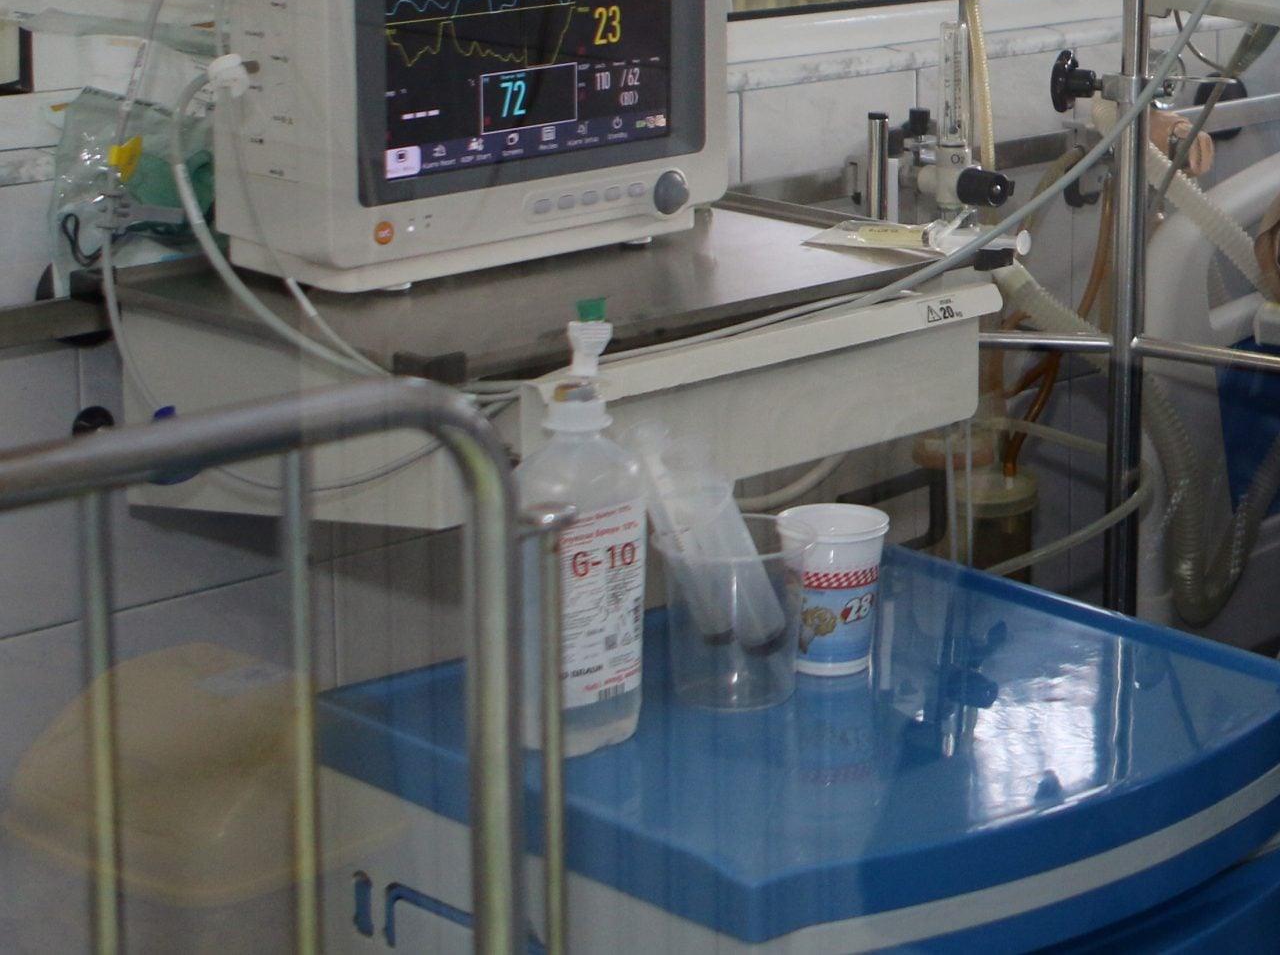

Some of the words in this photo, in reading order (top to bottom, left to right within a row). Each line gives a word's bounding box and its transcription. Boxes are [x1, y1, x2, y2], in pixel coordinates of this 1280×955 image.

[594, 5, 621, 45] 23
[500, 80, 527, 118] 72
[939, 306, 954, 320] 20
[571, 541, 637, 579] G-10
[844, 592, 872, 624] 28
